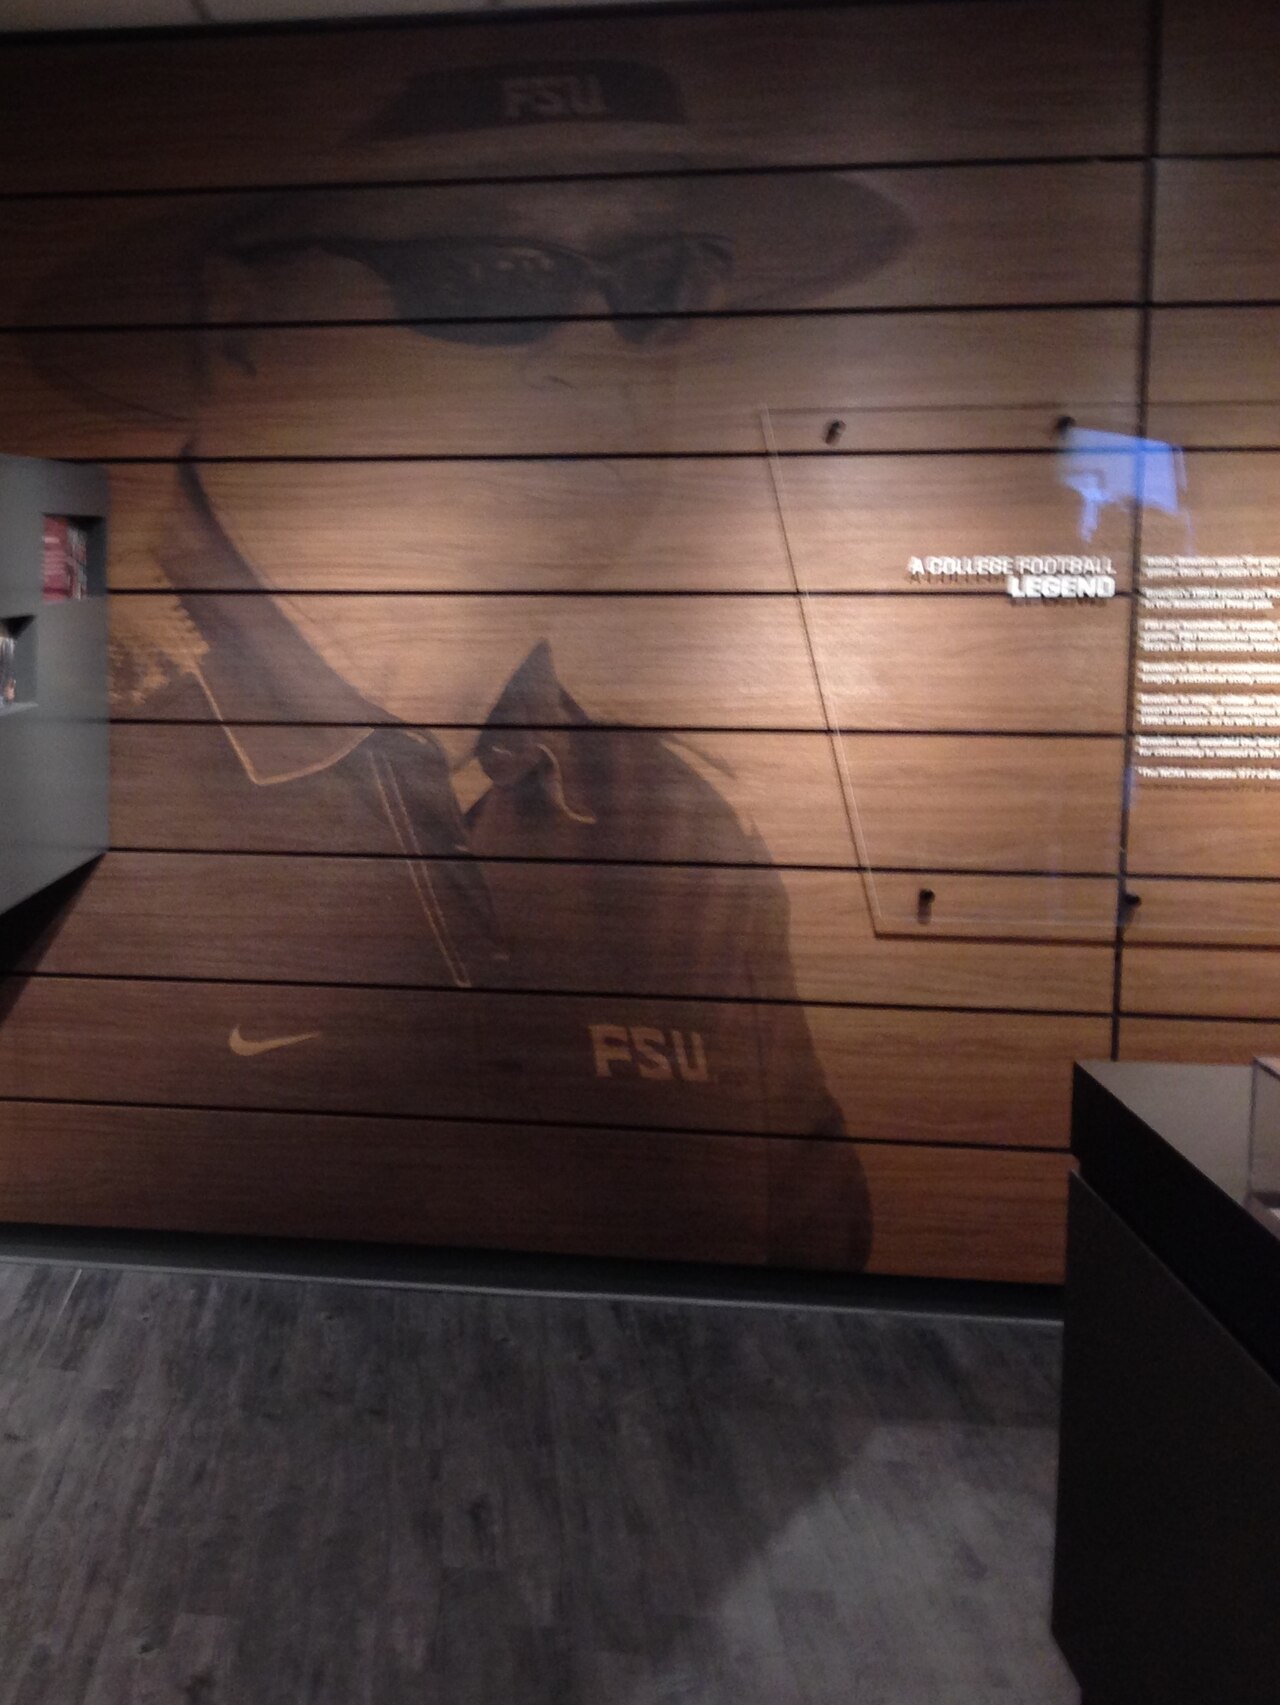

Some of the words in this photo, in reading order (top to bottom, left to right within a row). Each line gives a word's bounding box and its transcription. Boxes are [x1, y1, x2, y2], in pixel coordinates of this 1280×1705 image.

[502, 74, 606, 115] FSU
[909, 555, 925, 575] A
[926, 555, 1014, 575] COLLEGE
[1014, 555, 1117, 575] FOOTBALL
[1007, 574, 1116, 598] LEGEND
[588, 1023, 710, 1083] FSU
